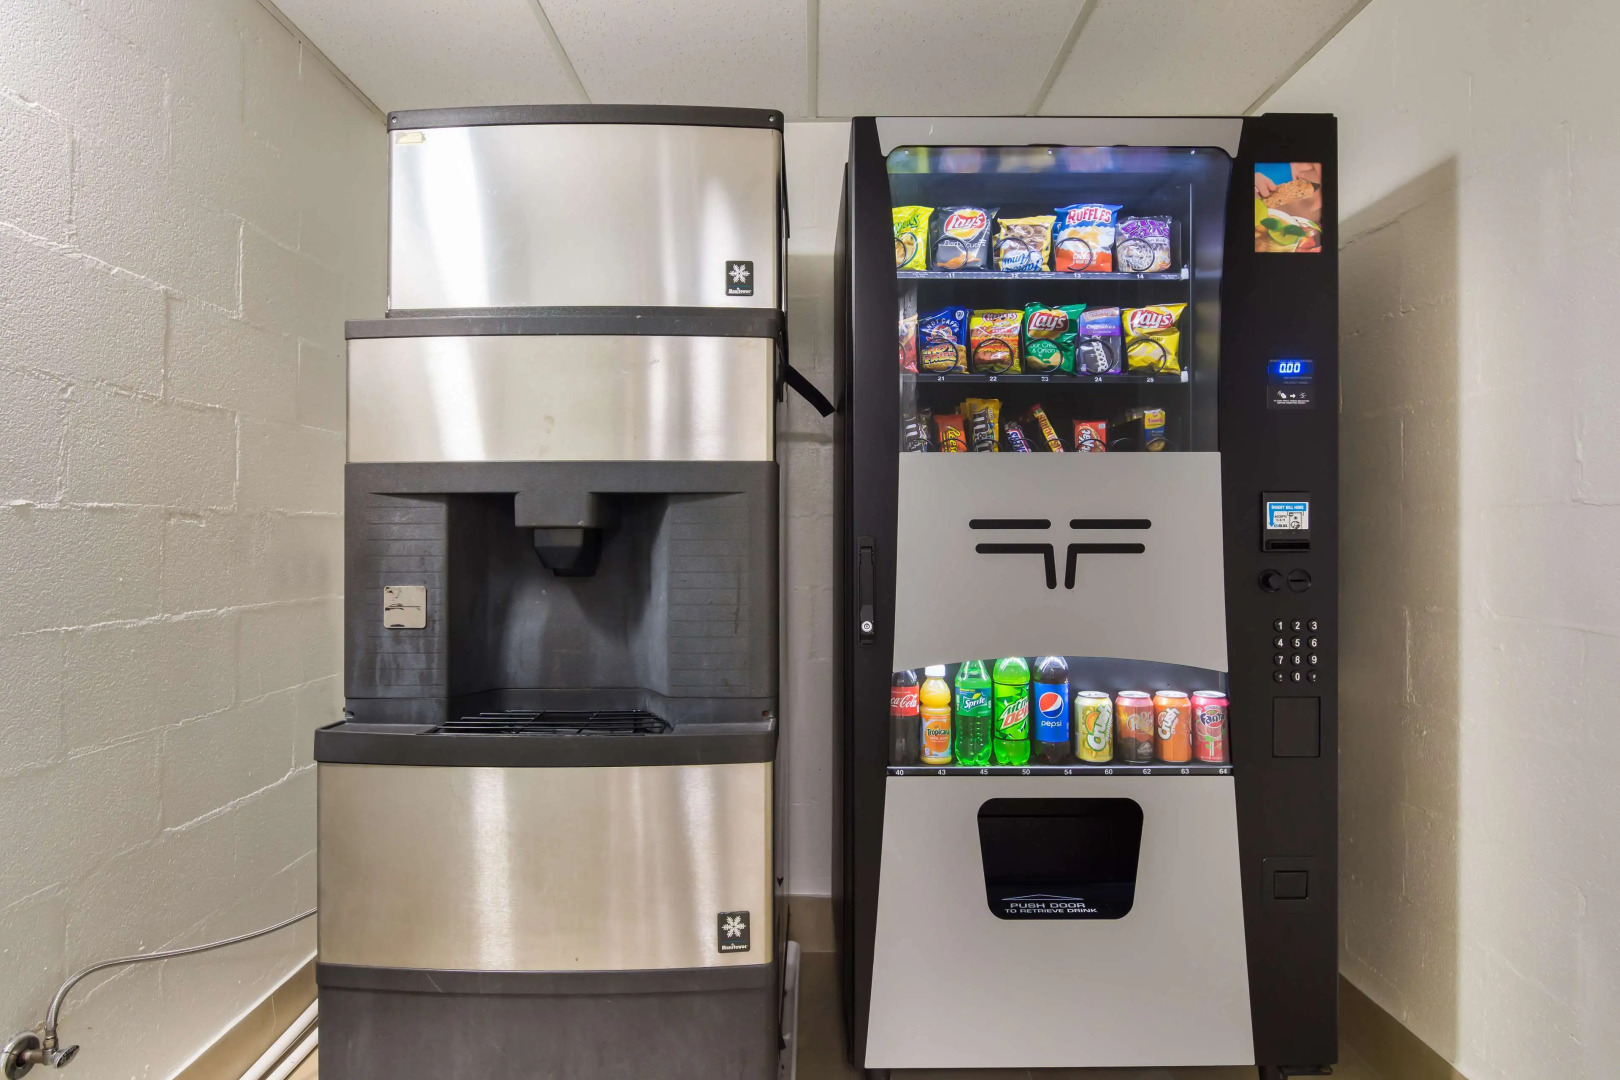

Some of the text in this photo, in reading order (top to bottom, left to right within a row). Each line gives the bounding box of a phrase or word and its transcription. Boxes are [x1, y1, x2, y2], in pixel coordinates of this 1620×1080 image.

[1066, 207, 1112, 225] RUFFLES
[1029, 312, 1066, 331] Lay's
[1132, 310, 1171, 329] Lay's
[1278, 621, 1317, 630] 1 2 3
[1278, 639, 1317, 647] 4 5 6
[1278, 656, 1317, 664] 7 8 9
[1295, 673, 1300, 681] 0
[964, 696, 986, 709] Sprite
[1041, 720, 1062, 728] pepsi
[1157, 707, 1180, 740] Crush
[1200, 712, 1225, 725] Fanta
[926, 728, 950, 736] Tropicana
[1087, 704, 1113, 752] Crush
